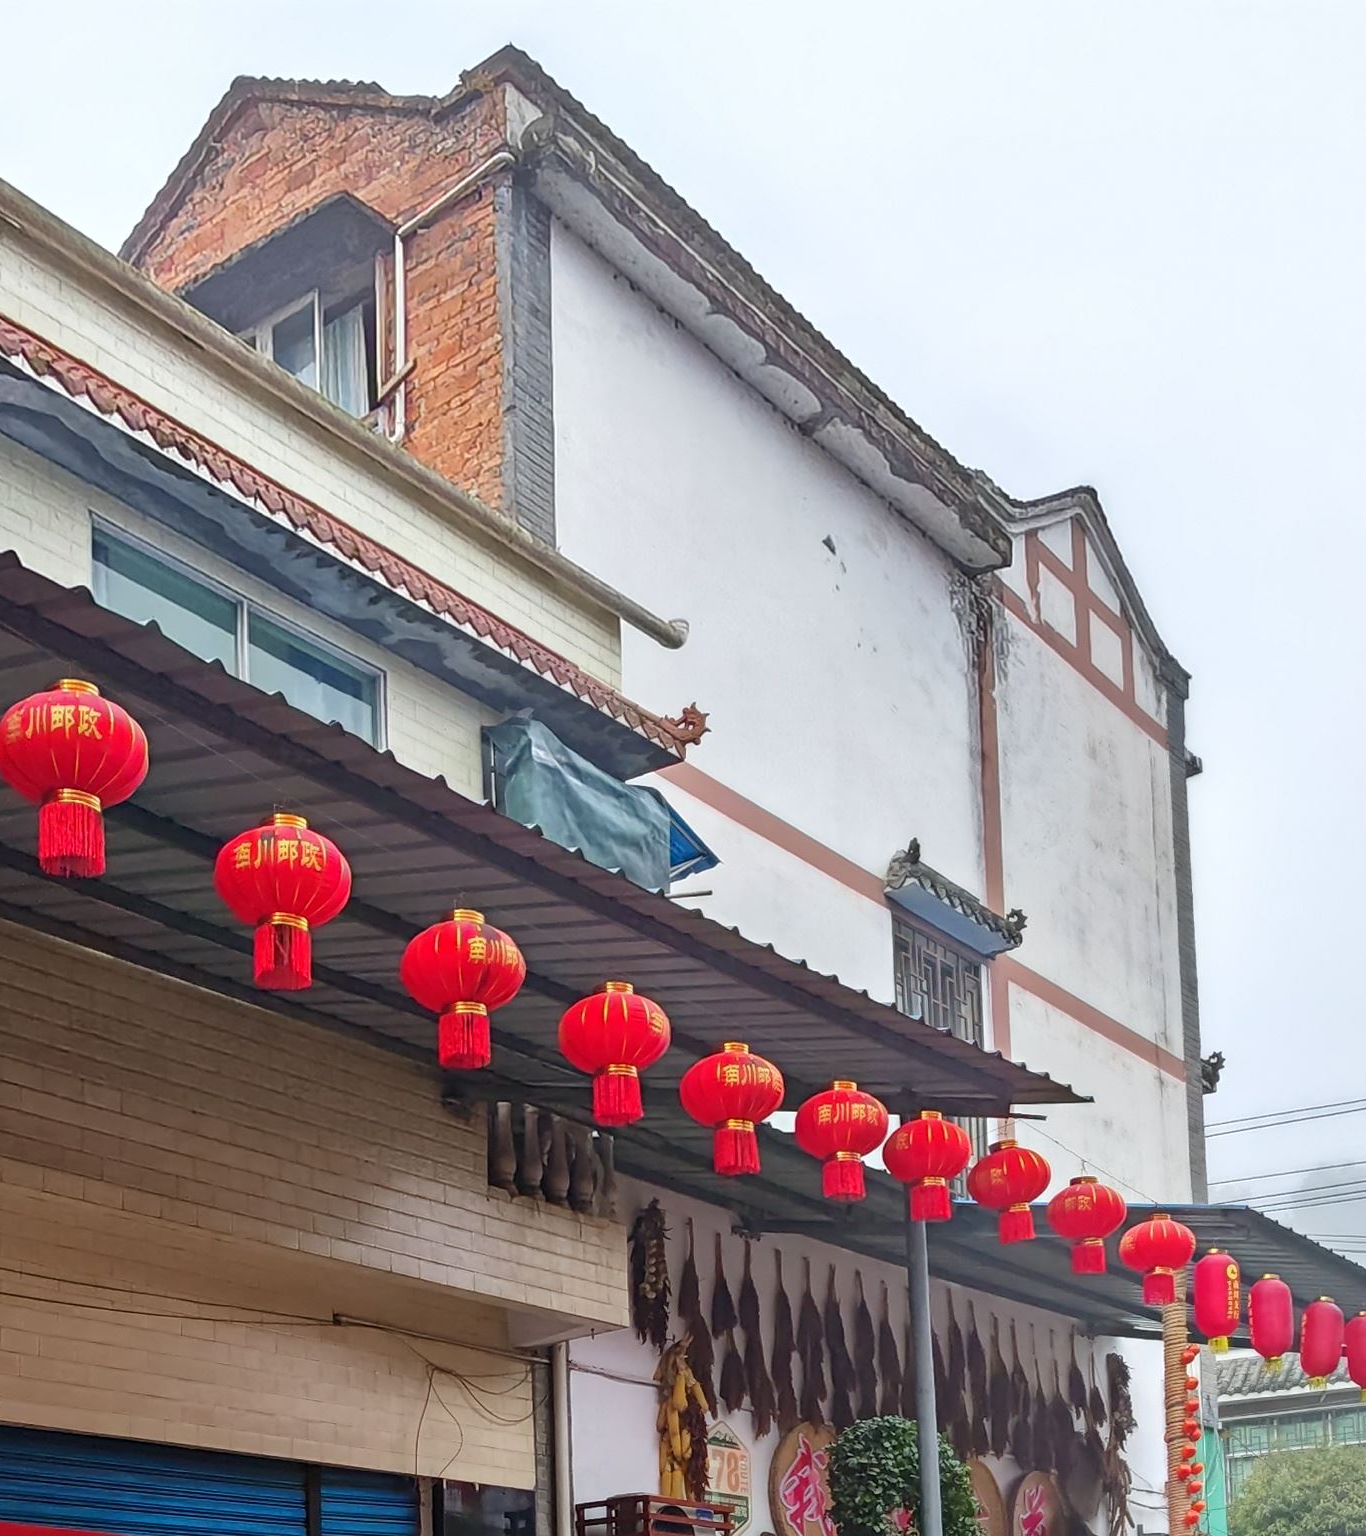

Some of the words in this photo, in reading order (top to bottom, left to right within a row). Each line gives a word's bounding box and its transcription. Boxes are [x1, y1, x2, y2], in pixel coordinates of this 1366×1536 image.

[234, 837, 323, 871] 南川邮政
[817, 1101, 880, 1126] 南川邮政
